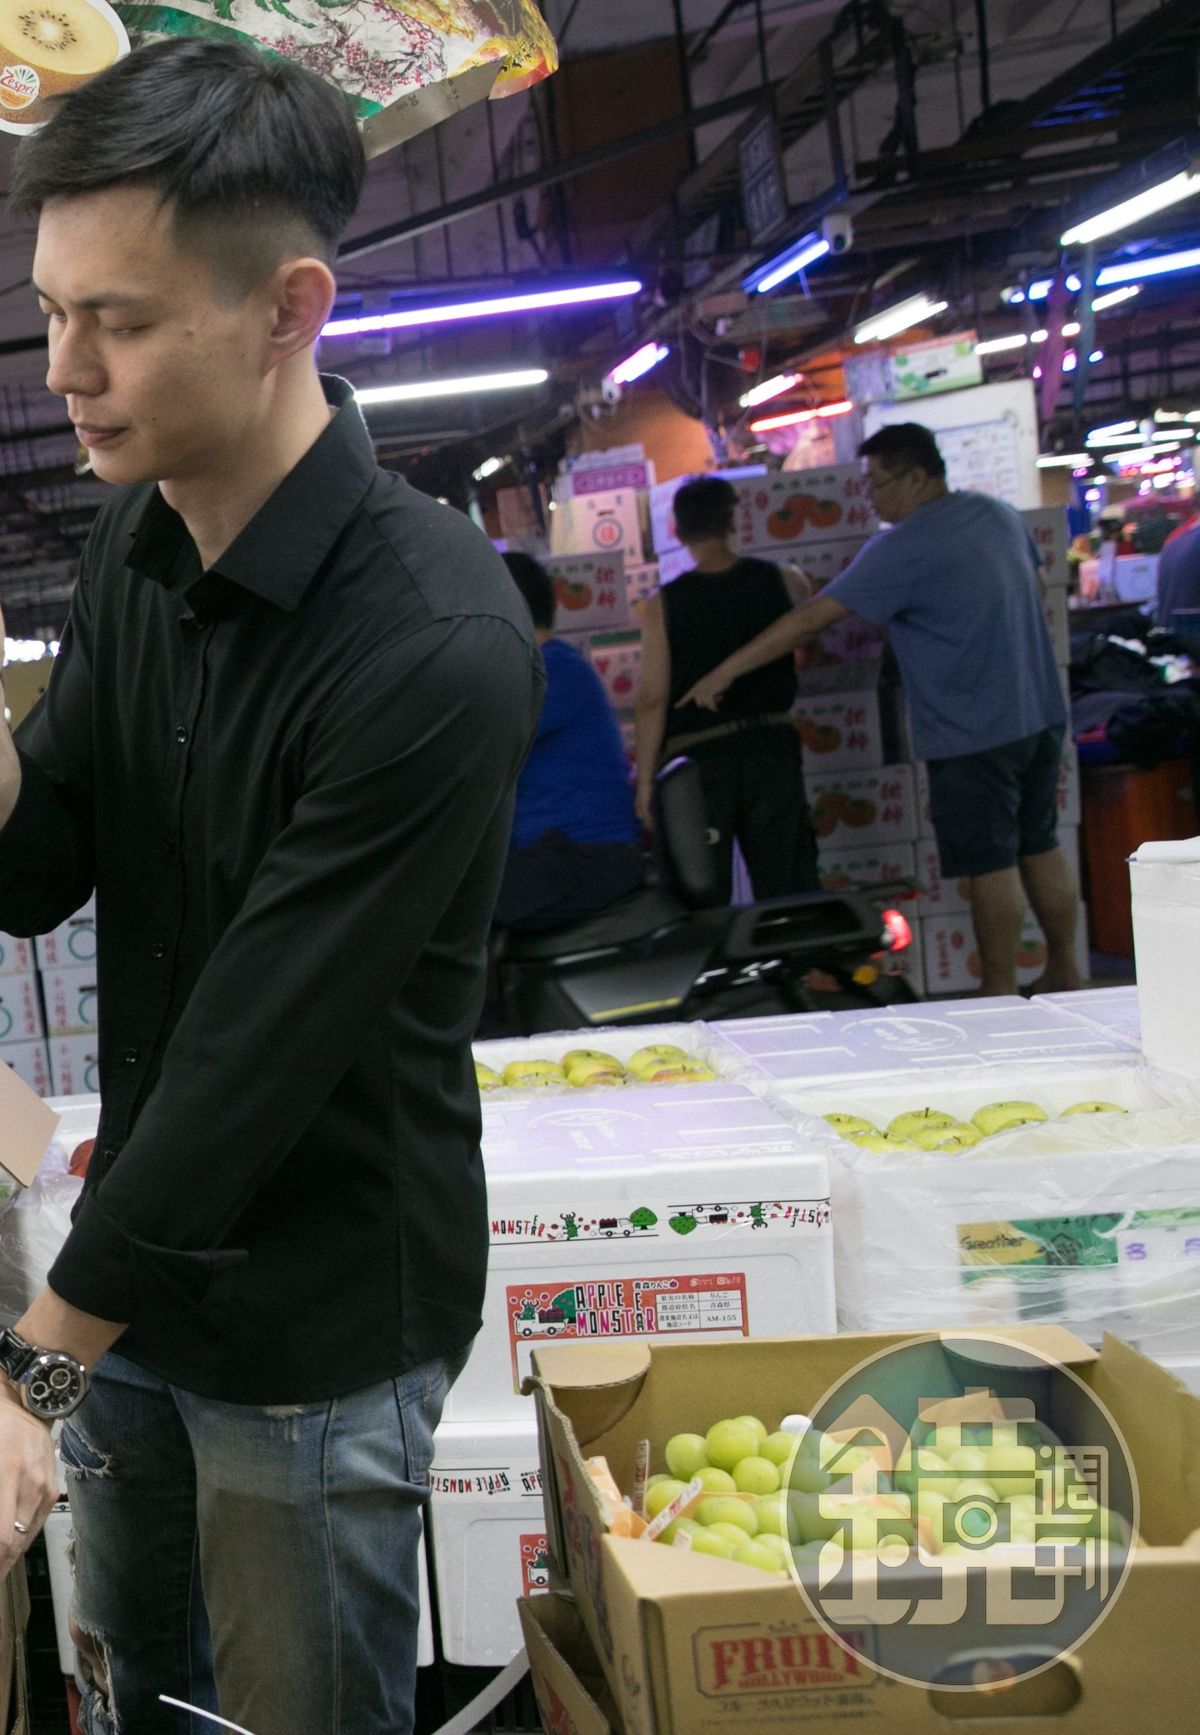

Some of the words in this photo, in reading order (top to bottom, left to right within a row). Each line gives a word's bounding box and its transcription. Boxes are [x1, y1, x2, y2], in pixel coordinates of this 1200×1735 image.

[0, 69, 35, 95] Zespri
[574, 1283, 624, 1309] APPLE
[475, 1472, 510, 1492] APPLE
[709, 1630, 866, 1690] FRUIT
